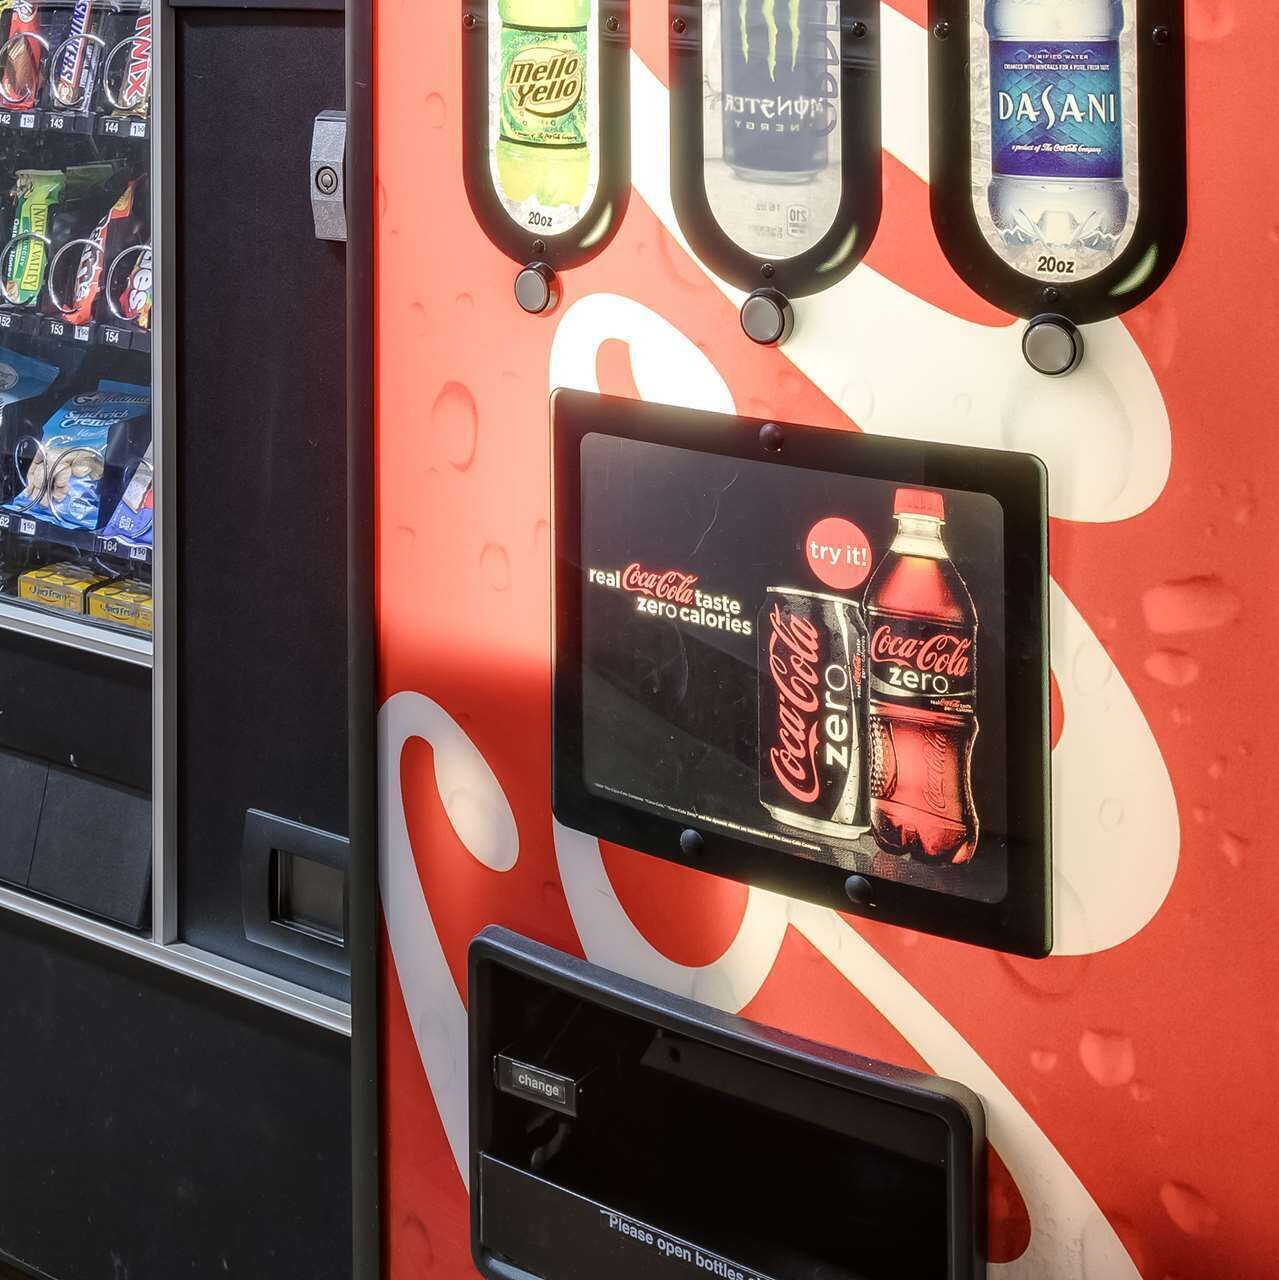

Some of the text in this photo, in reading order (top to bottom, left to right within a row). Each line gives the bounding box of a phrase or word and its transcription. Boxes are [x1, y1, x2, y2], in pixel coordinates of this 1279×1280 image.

[509, 57, 578, 84] Mello
[517, 79, 577, 107] Yello
[998, 84, 1115, 130] DASANI
[50, 118, 64, 129] 143
[105, 122, 119, 133] 144
[528, 210, 553, 228] 20oz
[1036, 256, 1076, 275] 20oz
[50, 324, 64, 336] 153
[104, 331, 120, 342] 154
[103, 540, 118, 552] 164
[808, 542, 868, 568] try it!
[588, 562, 741, 615] real Coca-Cola taste
[636, 596, 753, 636] zero calories
[870, 624, 972, 678] Coca-Cola
[888, 666, 949, 694] zero
[768, 602, 820, 804] Coca-Cola
[824, 662, 850, 771] zero
[518, 1072, 560, 1098] change
[608, 1213, 745, 1280] Please open bottles
